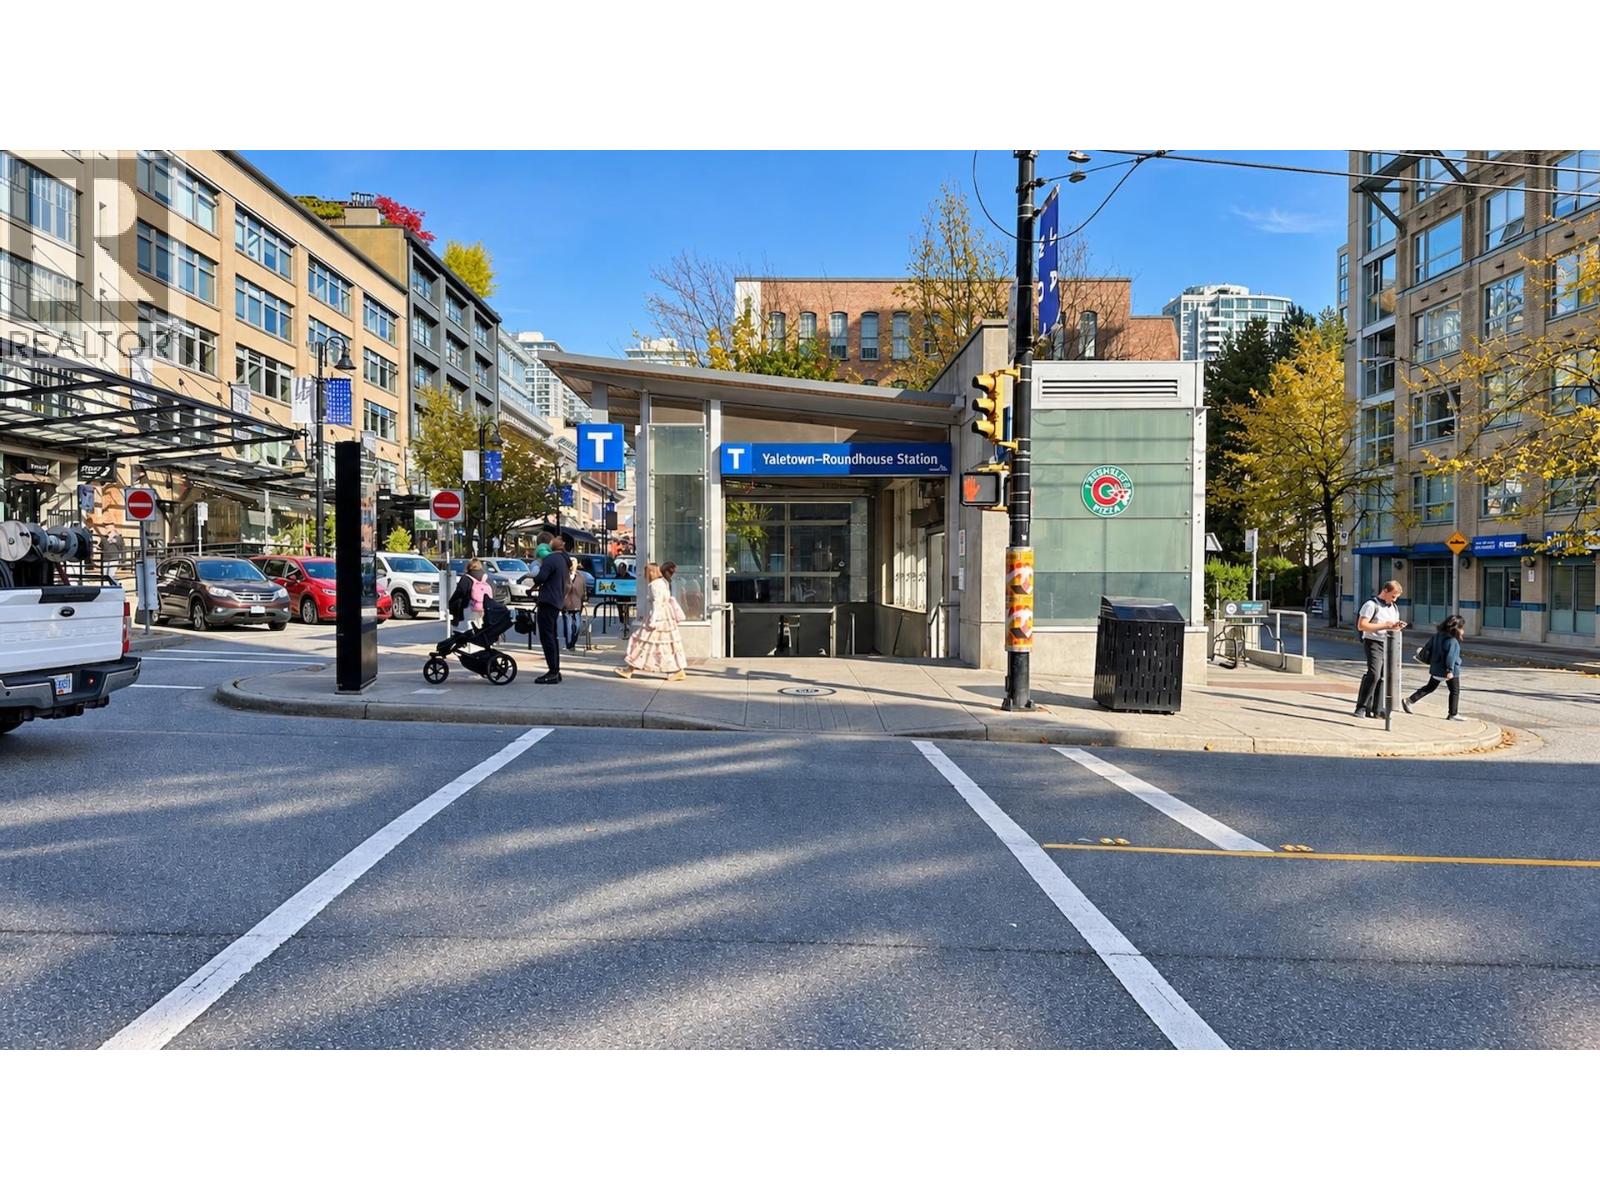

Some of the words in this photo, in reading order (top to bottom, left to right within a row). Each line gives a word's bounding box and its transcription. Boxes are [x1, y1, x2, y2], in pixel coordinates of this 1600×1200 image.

[587, 431, 613, 463] T
[727, 448, 745, 469] T
[897, 453, 938, 466] Station
